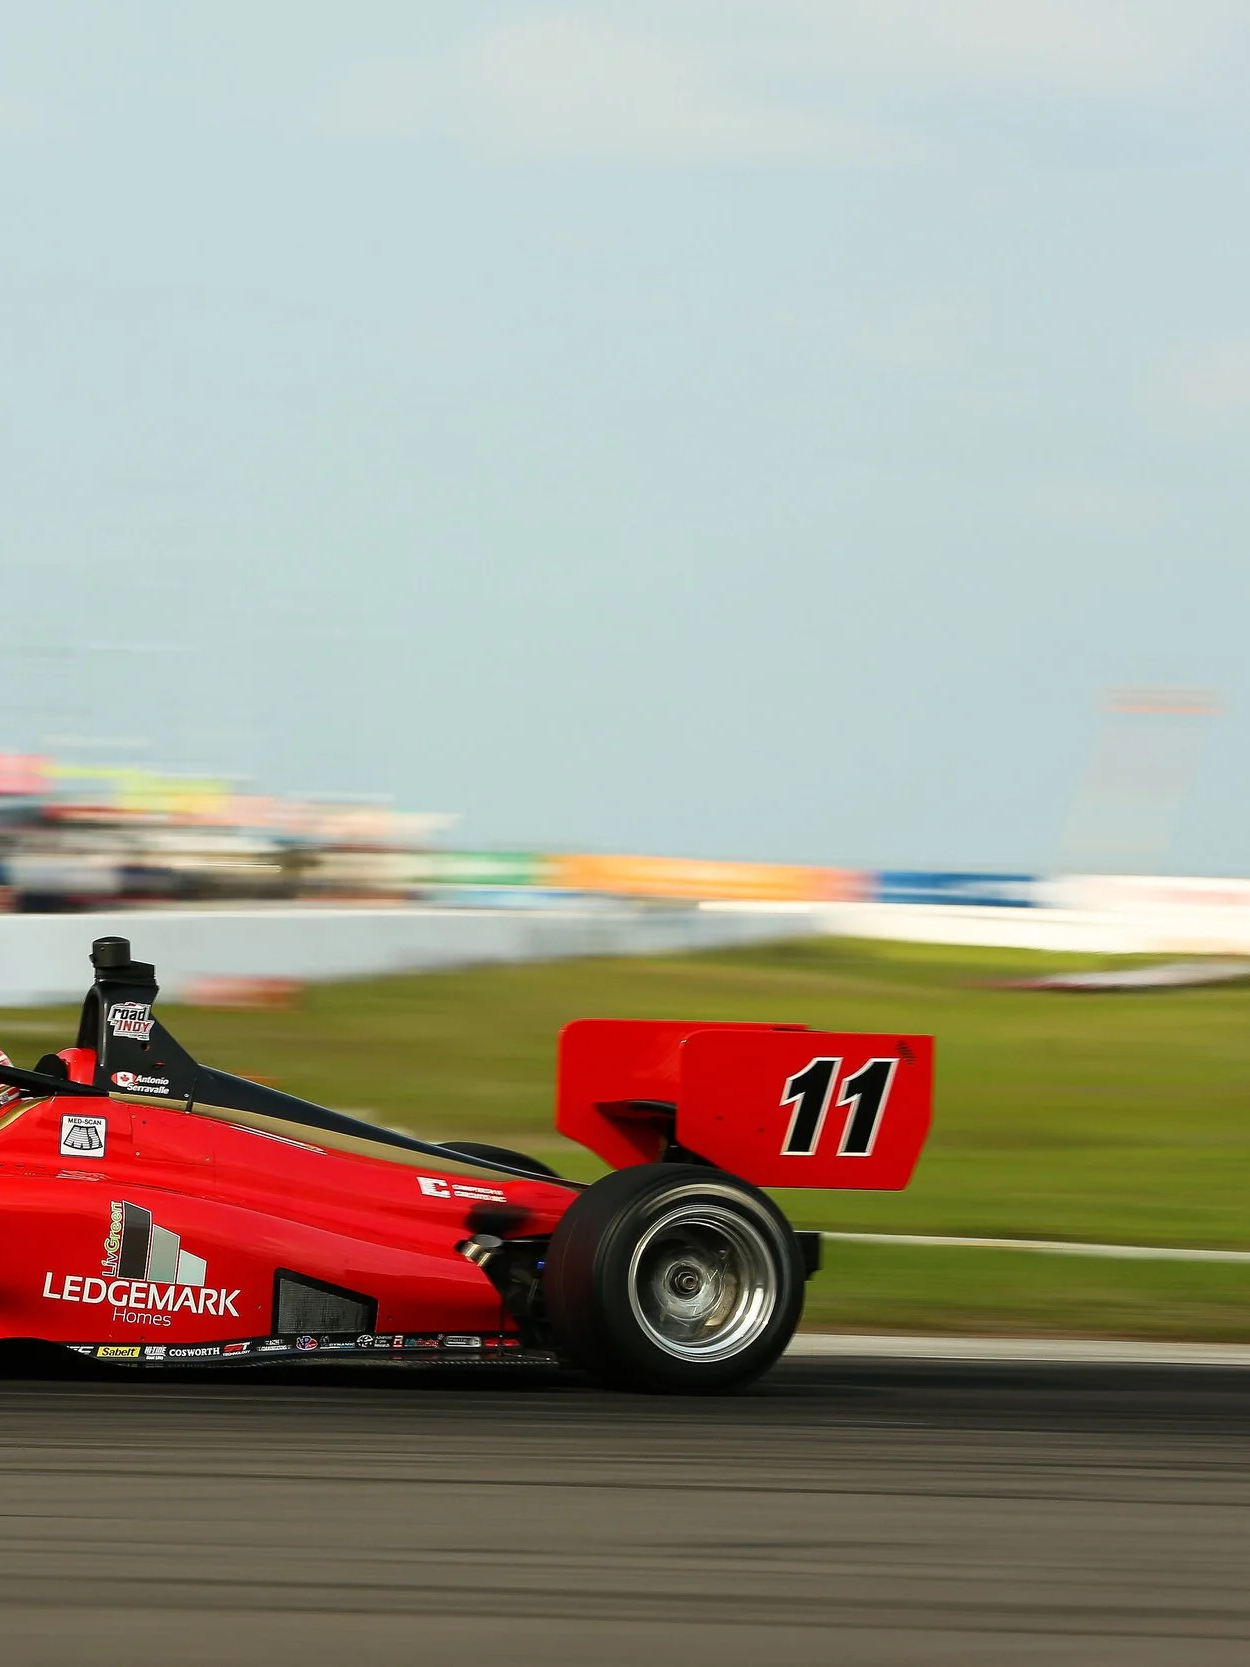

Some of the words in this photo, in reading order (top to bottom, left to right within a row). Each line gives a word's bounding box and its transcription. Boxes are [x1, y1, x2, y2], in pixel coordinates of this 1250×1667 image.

[112, 1007, 147, 1021] road
[117, 1020, 150, 1033] INDY
[136, 1075, 169, 1085] Antonio
[127, 1082, 170, 1094] Serravalle
[779, 1057, 901, 1157] 11
[67, 1117, 102, 1126] MED-SCAN
[101, 1200, 123, 1277] LivGreen
[42, 1272, 242, 1317] LEDGEMARK
[112, 1307, 172, 1327] Homes
[102, 1347, 136, 1357] Sabelt
[169, 1346, 221, 1357] COSWORTH
